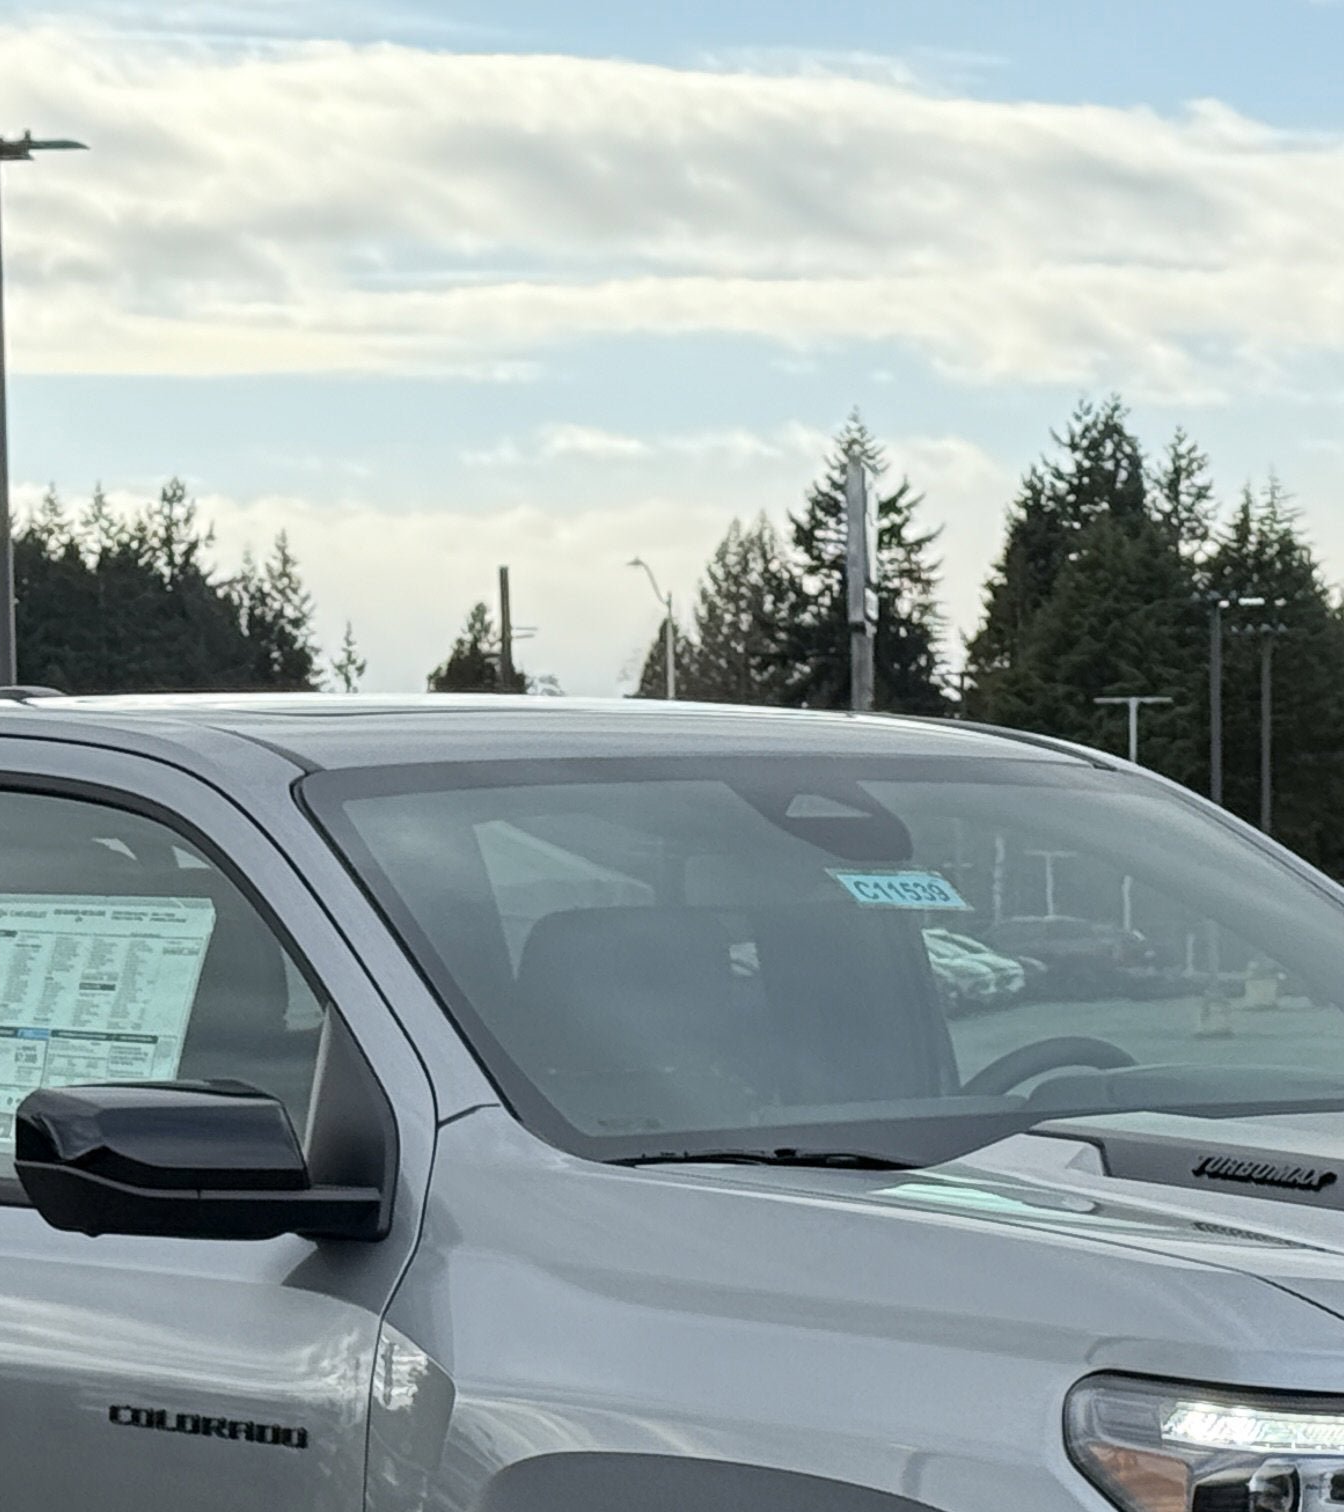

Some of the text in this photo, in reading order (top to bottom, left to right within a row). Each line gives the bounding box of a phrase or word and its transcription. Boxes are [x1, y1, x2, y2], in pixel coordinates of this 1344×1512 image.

[855, 880, 950, 903] C11539
[1193, 1155, 1335, 1191] TURBOMAX
[109, 1405, 308, 1449] COLORADO
